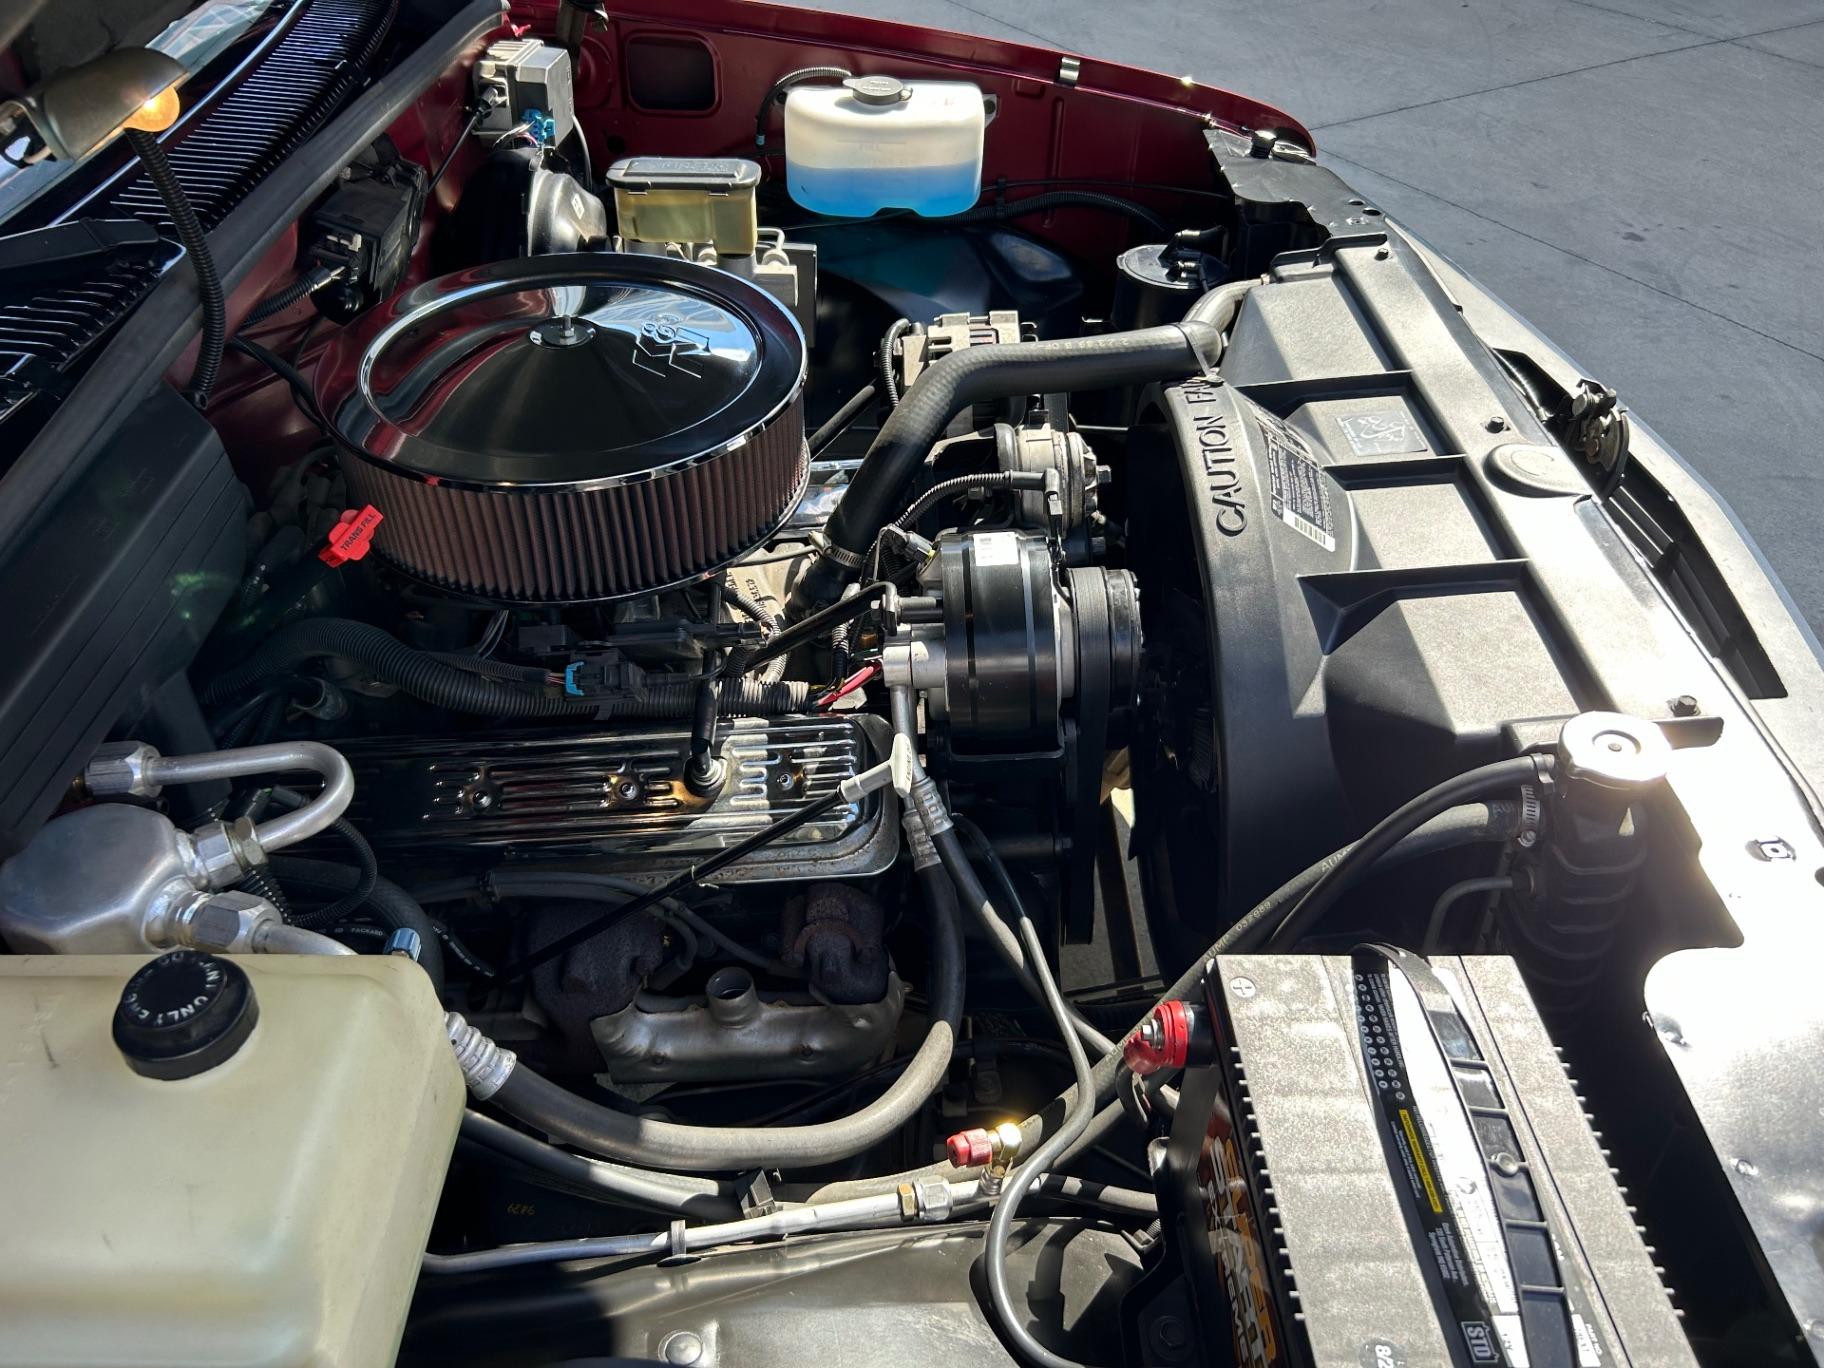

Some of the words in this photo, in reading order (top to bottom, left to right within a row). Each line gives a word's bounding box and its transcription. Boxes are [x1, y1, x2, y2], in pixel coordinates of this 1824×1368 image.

[1193, 415, 1248, 537] CAUTION
[340, 526, 363, 551] TRANS
[154, 995, 209, 1025] ONLY
[1466, 1327, 1493, 1358] STD
